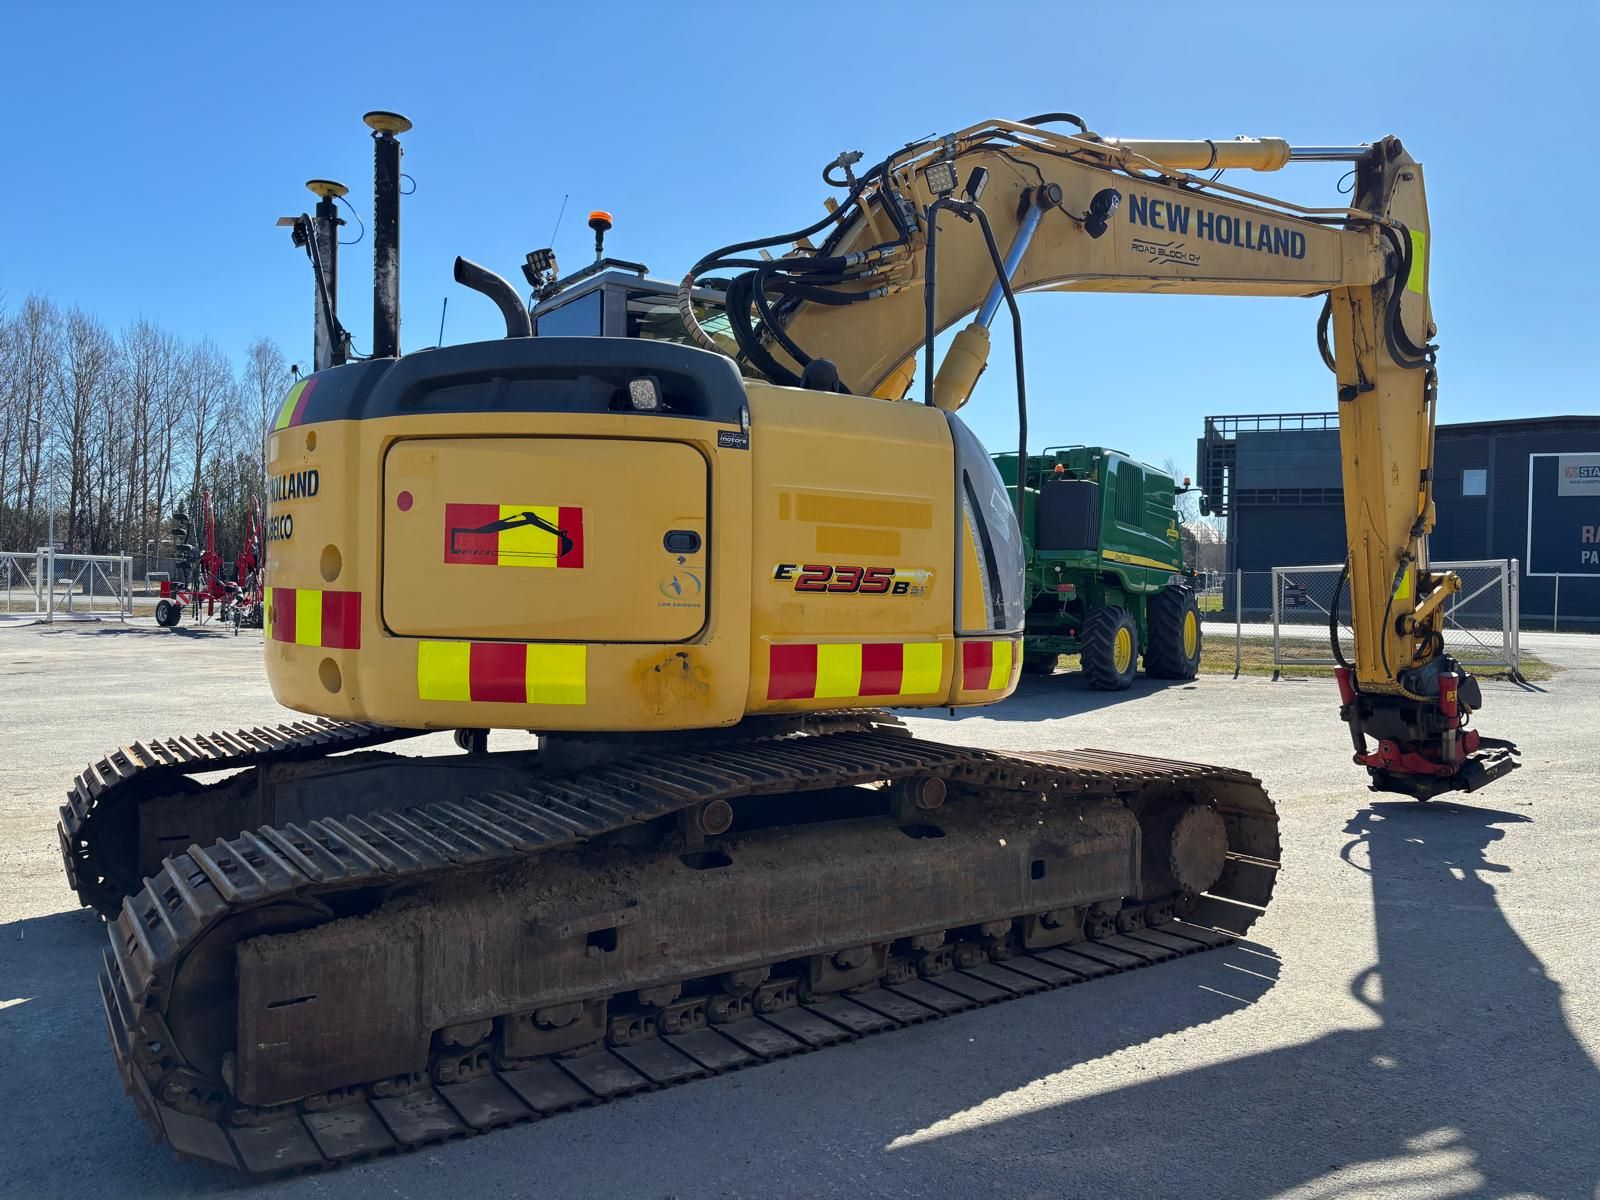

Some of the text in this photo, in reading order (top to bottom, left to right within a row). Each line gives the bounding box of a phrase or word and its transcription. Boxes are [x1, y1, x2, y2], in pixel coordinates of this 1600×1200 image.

[1129, 193, 1306, 260] NEW HOLLAND
[1131, 243, 1156, 255] ROAD
